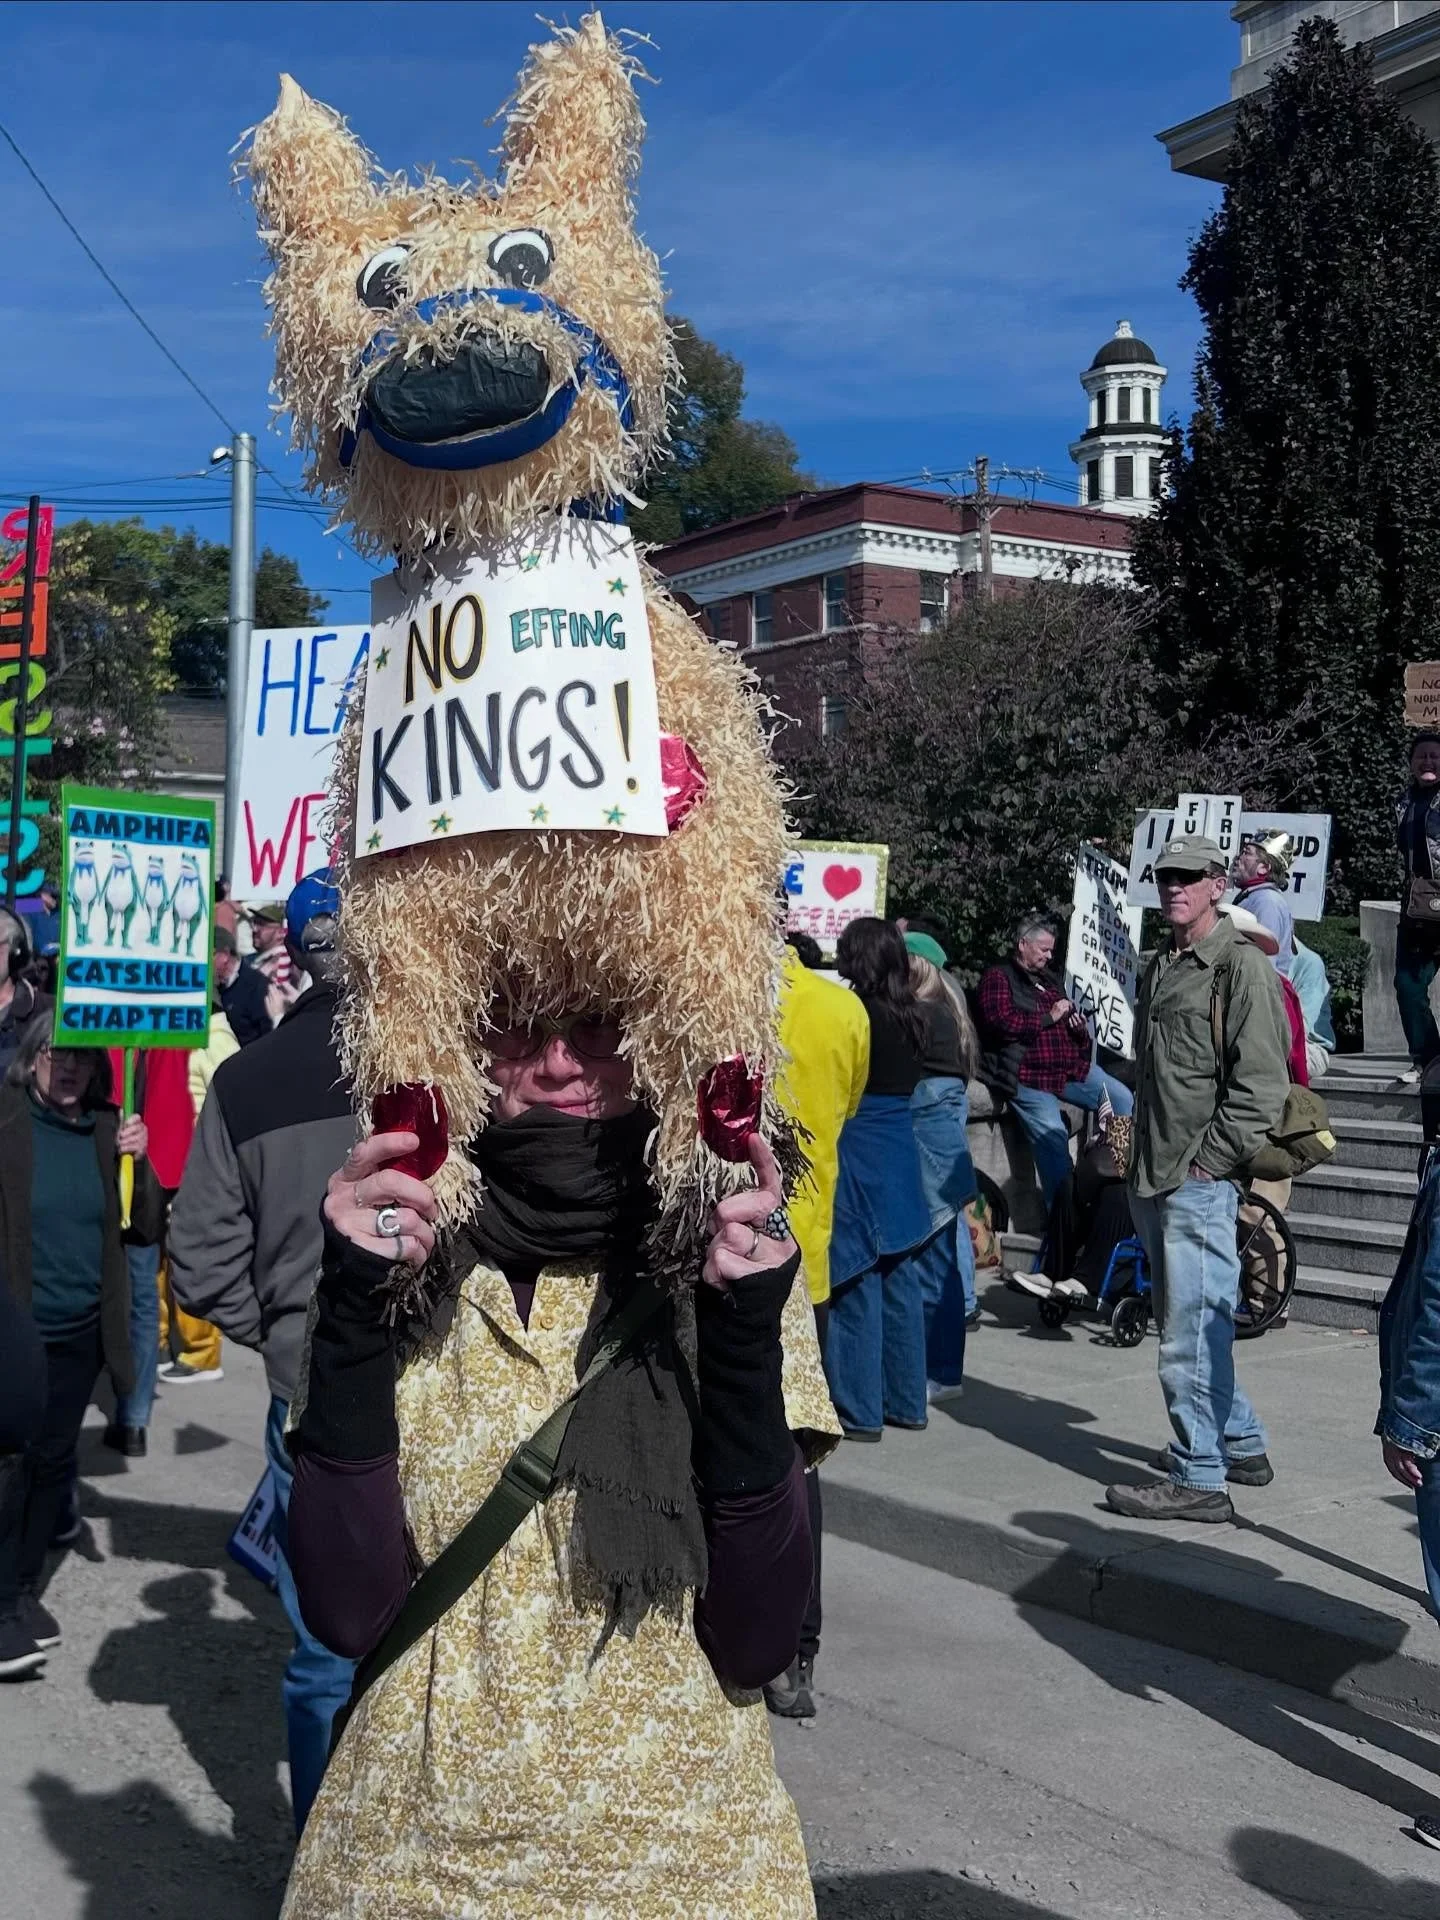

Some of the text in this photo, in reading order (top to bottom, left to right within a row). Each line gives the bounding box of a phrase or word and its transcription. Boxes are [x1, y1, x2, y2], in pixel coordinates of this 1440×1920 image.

[403, 592, 626, 707] NO EFFING
[372, 678, 640, 824] KINGS!
[70, 811, 210, 845] AMPHIFA
[244, 793, 342, 888] WE
[1084, 852, 1128, 894] TRUM
[1092, 903, 1131, 936] FELON
[1114, 901, 1123, 914] A
[1081, 933, 1133, 972] GRIFTER
[1084, 951, 1126, 985] FRAUD
[66, 959, 206, 988] CATSKILL
[63, 1005, 206, 1030] CHAPTER
[1071, 974, 1124, 1026] FAKE
